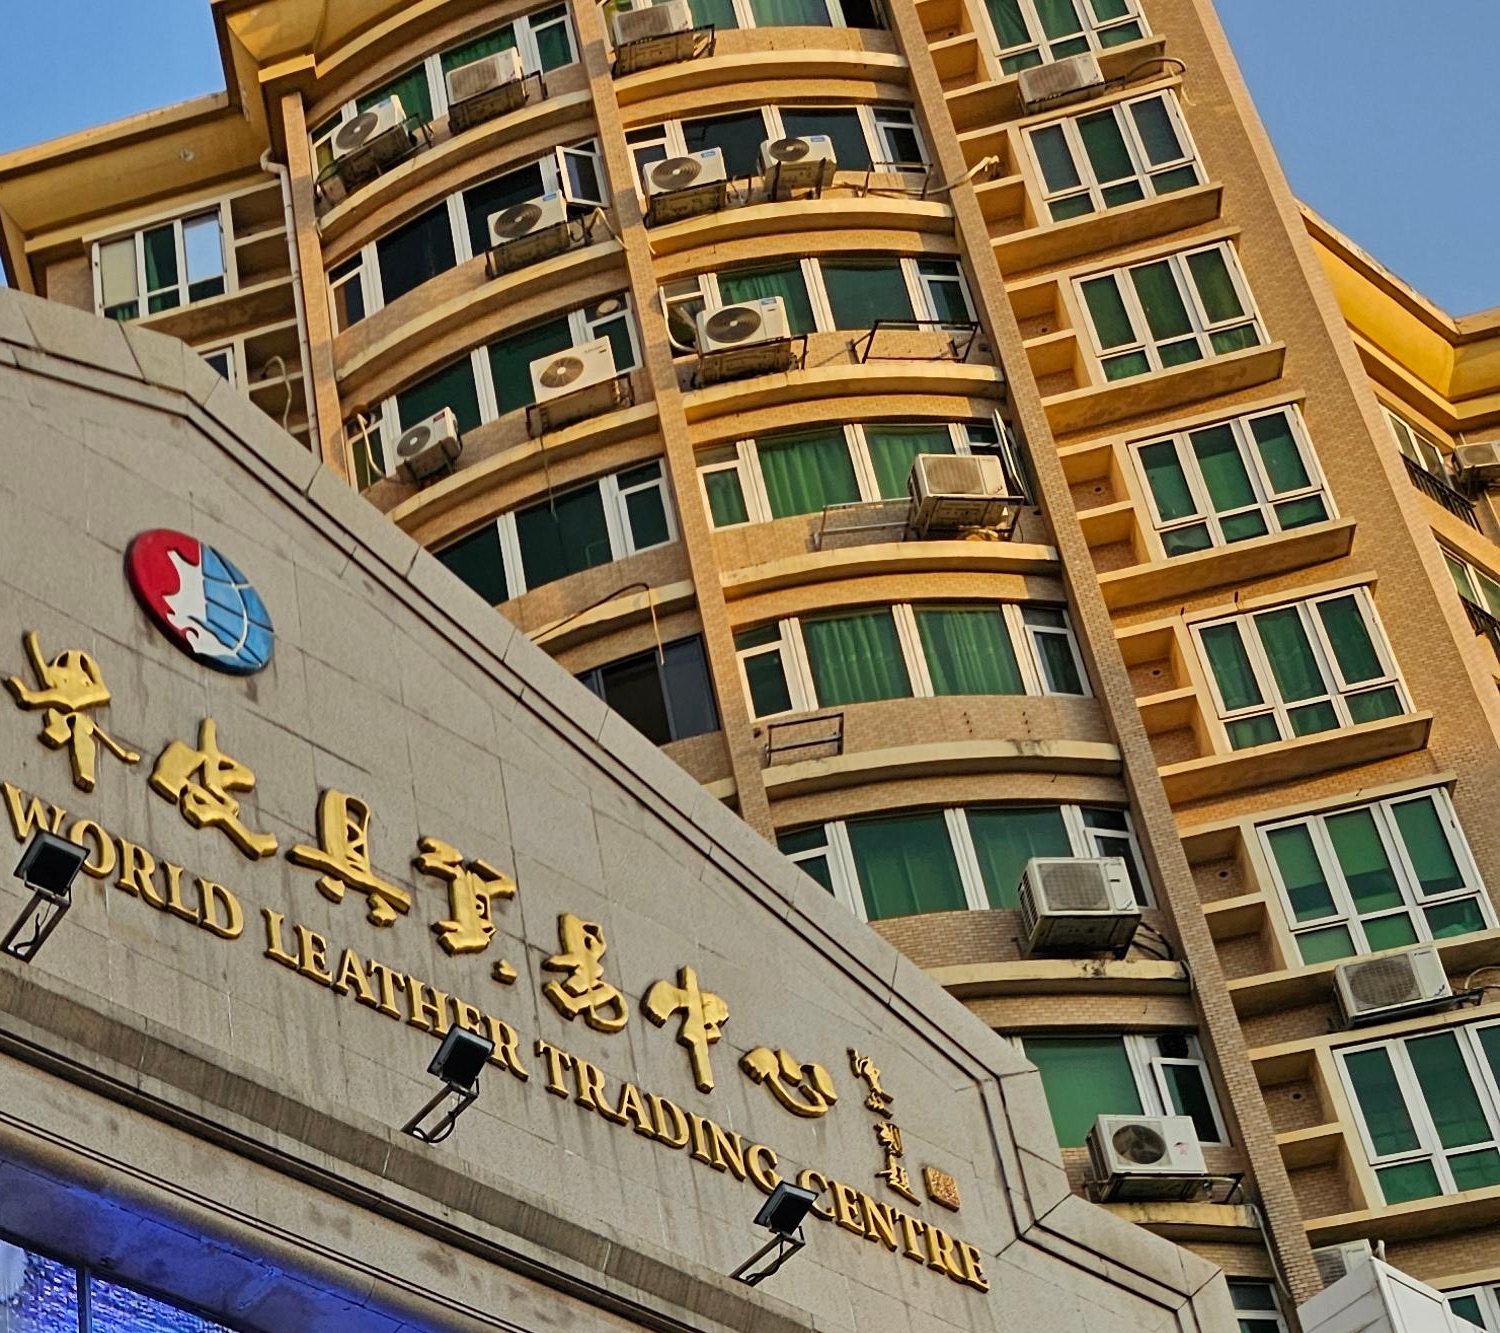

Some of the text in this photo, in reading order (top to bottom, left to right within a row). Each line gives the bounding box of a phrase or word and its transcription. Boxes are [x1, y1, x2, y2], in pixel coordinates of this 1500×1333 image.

[1, 782, 244, 939] WORLD
[261, 908, 529, 1081] LEATHER
[534, 1039, 781, 1194] TRADING
[800, 1170, 991, 1293] CENTRE
